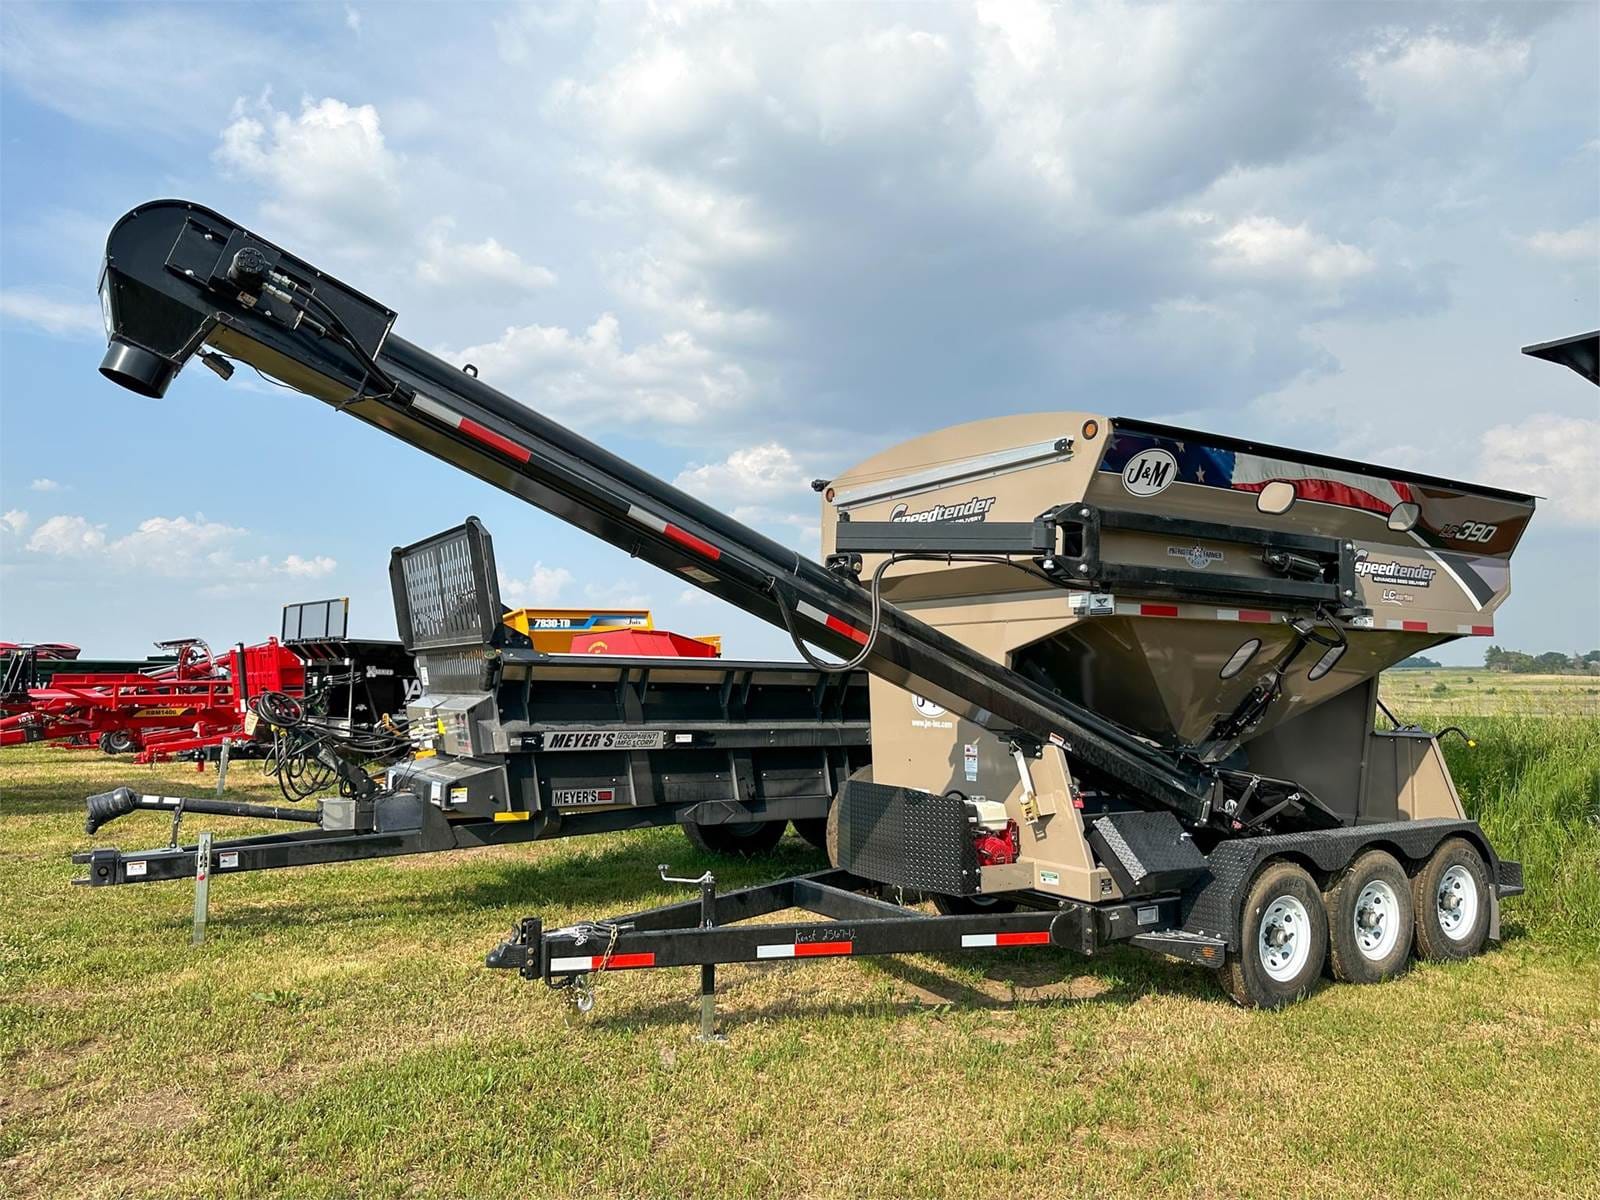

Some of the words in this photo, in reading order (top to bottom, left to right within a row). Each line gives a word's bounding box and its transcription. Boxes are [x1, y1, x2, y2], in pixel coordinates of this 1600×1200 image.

[1127, 458, 1172, 488] J&M
[549, 732, 616, 748] MEYER'S
[554, 789, 597, 805] MEYER'S
